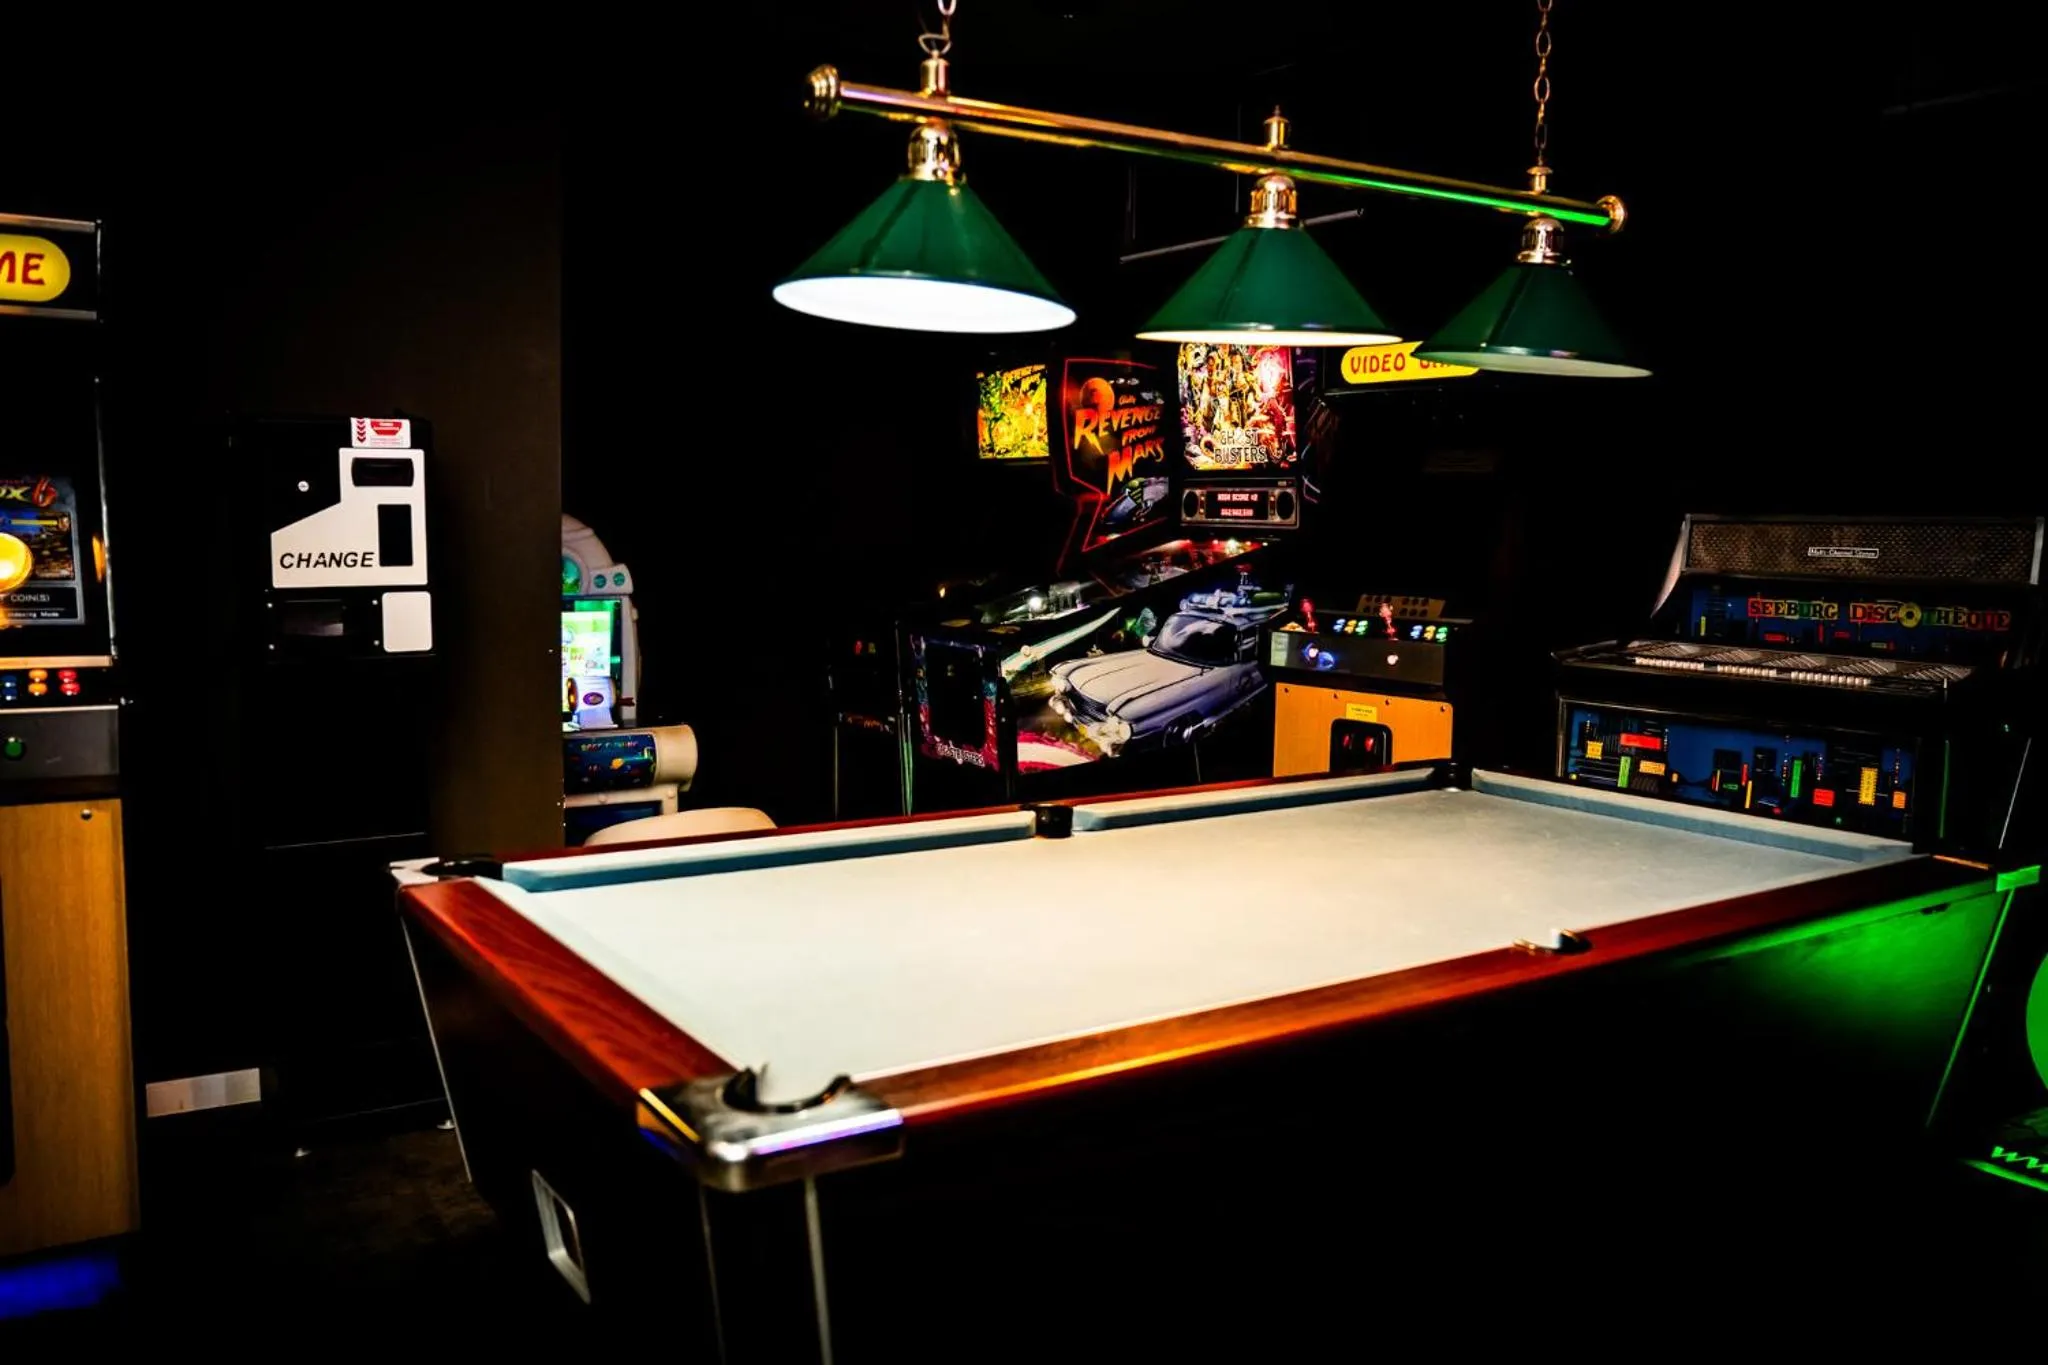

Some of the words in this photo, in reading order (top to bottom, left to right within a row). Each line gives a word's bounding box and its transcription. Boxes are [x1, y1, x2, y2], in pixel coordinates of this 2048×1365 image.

[1350, 352, 1406, 374] VIDEO
[1074, 406, 1161, 455] REVENGE
[1214, 446, 1267, 463] BUSTERS
[1107, 438, 1165, 496] MARS
[280, 552, 374, 569] CHANGE
[1749, 600, 1838, 619] SEEBURG
